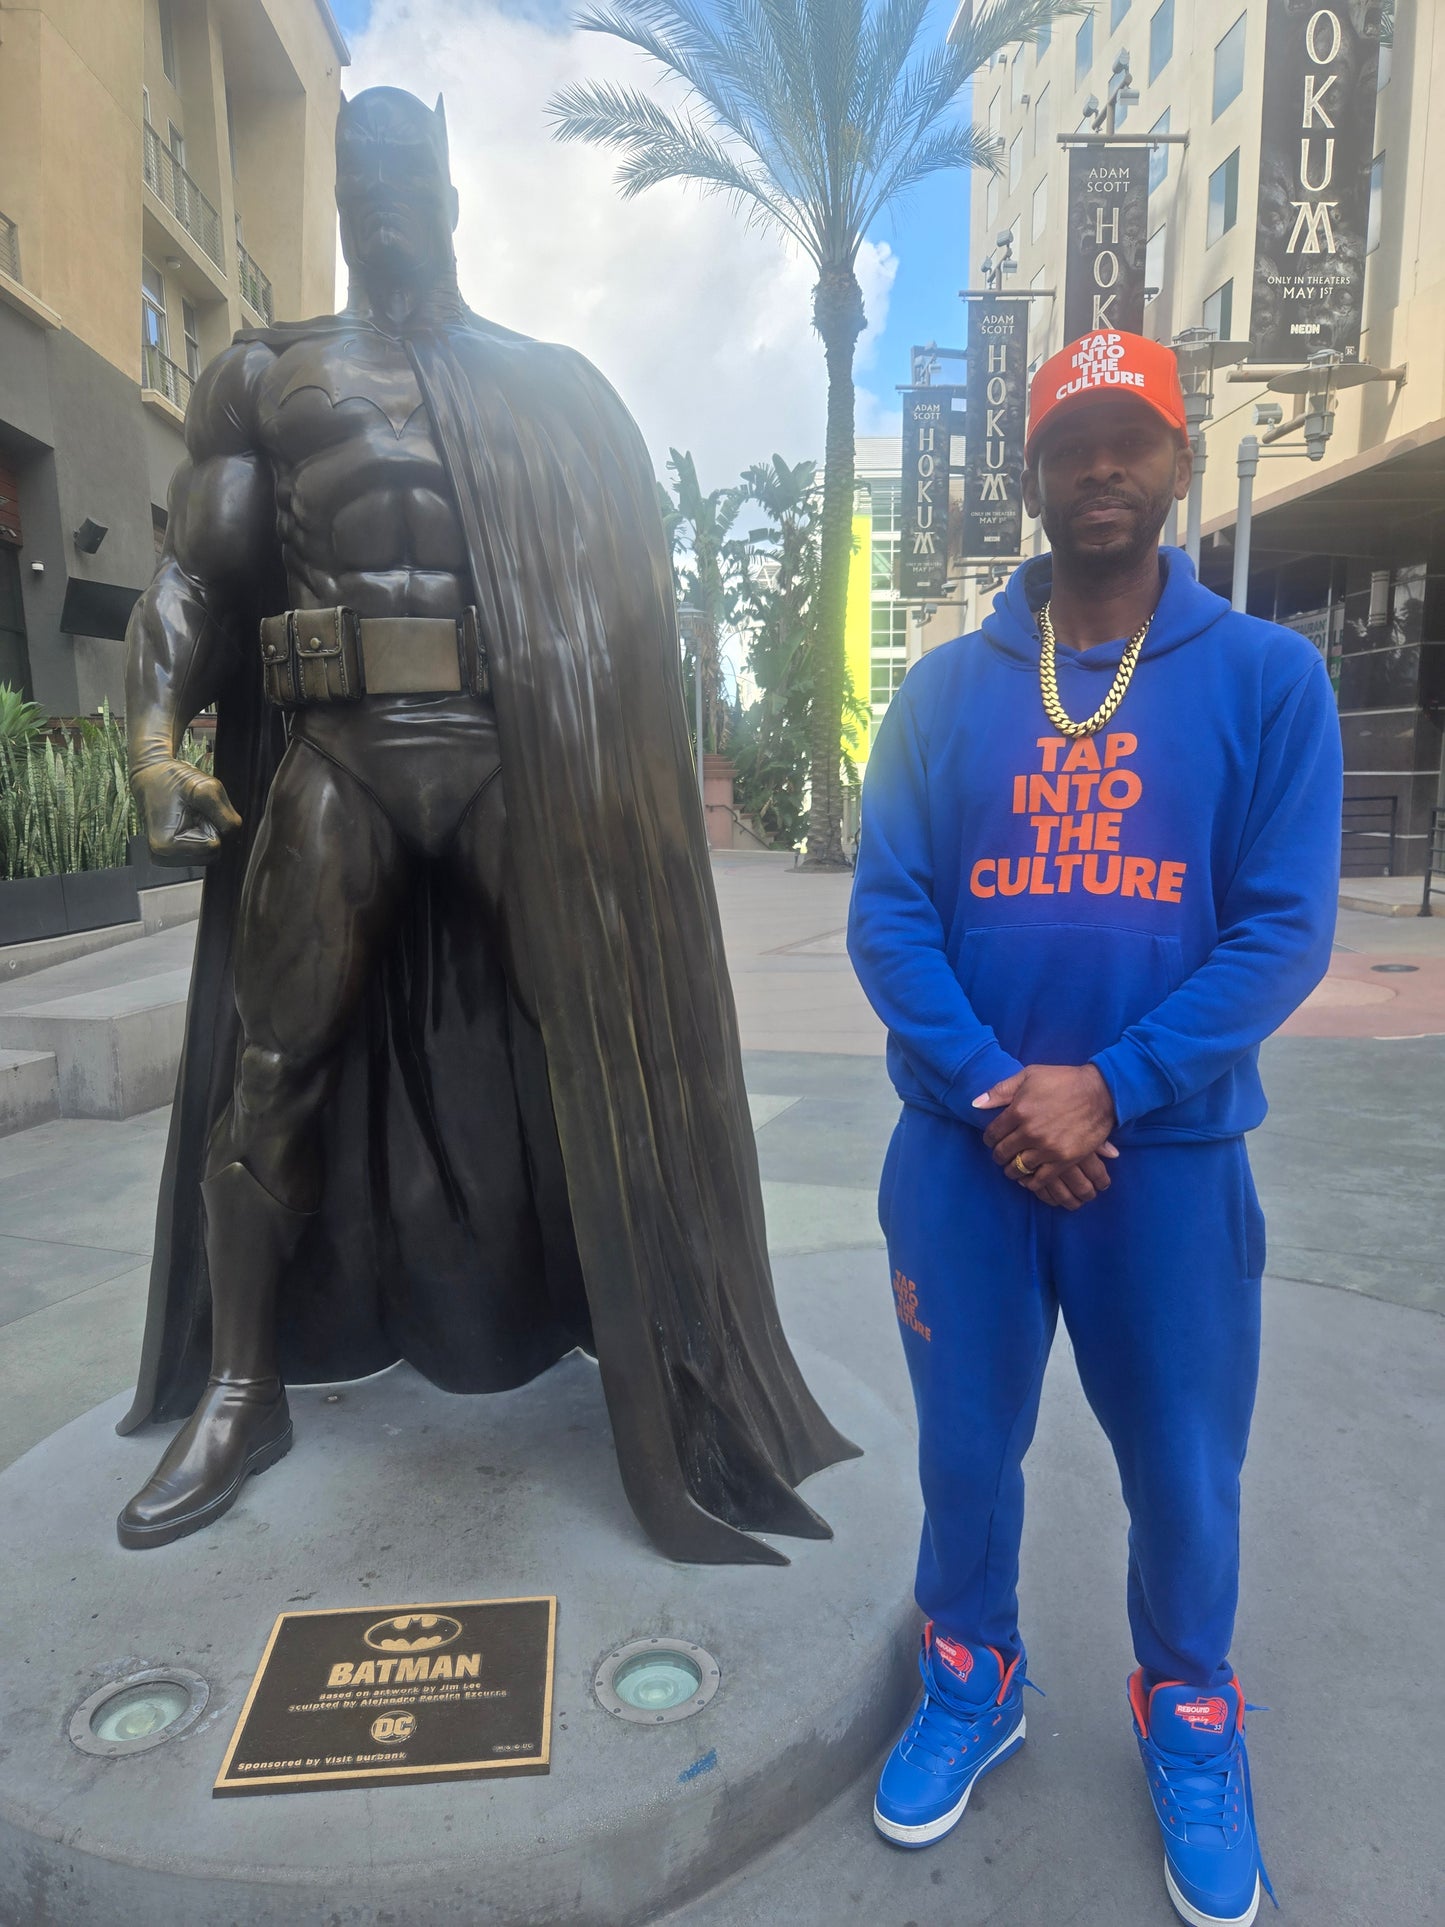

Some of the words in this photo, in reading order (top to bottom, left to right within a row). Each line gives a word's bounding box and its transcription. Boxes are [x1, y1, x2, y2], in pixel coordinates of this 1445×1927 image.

[1286, 9, 1341, 254] OKUM
[1089, 167, 1130, 179] ADAM
[1087, 181, 1130, 193] SCOTT
[1092, 207, 1119, 331] HOK
[1267, 276, 1292, 285] ONLY
[1294, 277, 1305, 285] IN
[1308, 276, 1351, 285] THEATERS
[1283, 286, 1315, 299] MAY
[1320, 286, 1334, 299] 1ST
[982, 315, 1014, 324] ADAM
[1290, 323, 1321, 335] NEON
[981, 325, 1015, 334] SCOTT
[1080, 333, 1121, 351] TAP
[1071, 344, 1125, 368] INTO
[1080, 358, 1119, 376] THE
[1056, 370, 1145, 400] CULTURE
[913, 412, 941, 420] SCOTT
[914, 404, 941, 412] ADAM
[980, 344, 1008, 501] HOKUM
[912, 428, 935, 554] HOKUM
[1036, 732, 1138, 772] TAP
[1012, 769, 1142, 814] INTO
[1030, 812, 1123, 853] THE
[969, 854, 1187, 903] CULTURE
[327, 1653, 482, 1688] BATMAN
[319, 1691, 352, 1701] Based
[355, 1690, 370, 1698] on
[373, 1686, 420, 1697] artwork
[423, 1685, 436, 1693] by
[440, 1683, 459, 1691] Jim
[463, 1682, 482, 1690] Lee
[343, 1700, 357, 1709] by
[361, 1696, 416, 1708] Alejandro
[420, 1692, 461, 1702] Pereira
[1177, 1705, 1210, 1714] REBOUND
[374, 1715, 414, 1738] DC
[237, 1759, 302, 1771] Sponsored
[305, 1757, 321, 1767] by
[325, 1755, 353, 1764] Visit
[356, 1752, 407, 1762] Burbank
